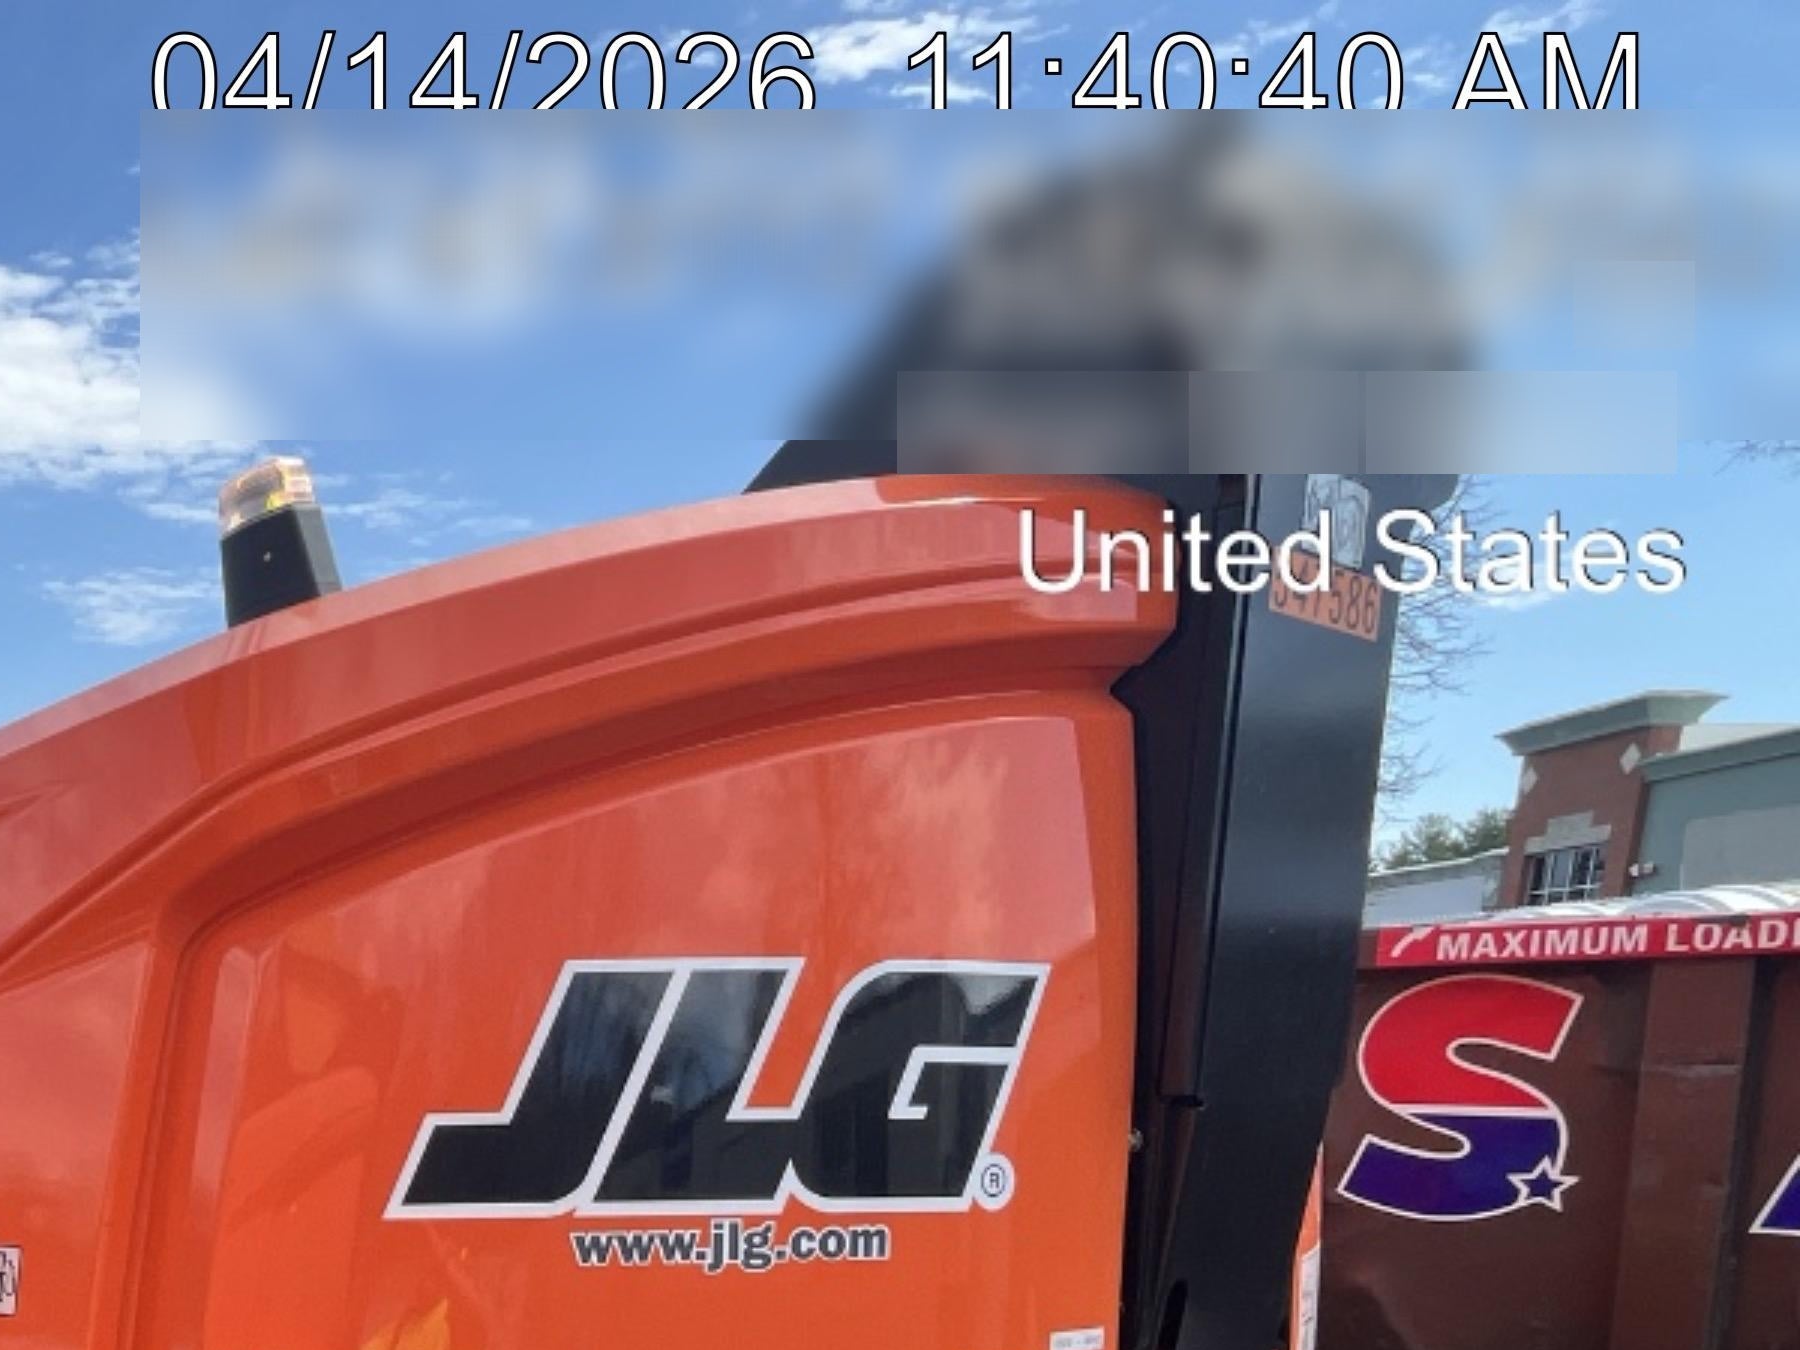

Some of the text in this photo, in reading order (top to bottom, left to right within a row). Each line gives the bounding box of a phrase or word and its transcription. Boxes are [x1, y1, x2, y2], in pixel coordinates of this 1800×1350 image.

[1435, 923, 1648, 962] MAXIMUM
[382, 956, 1052, 1219] JLG
[570, 1219, 890, 1274] www.jlg.com
